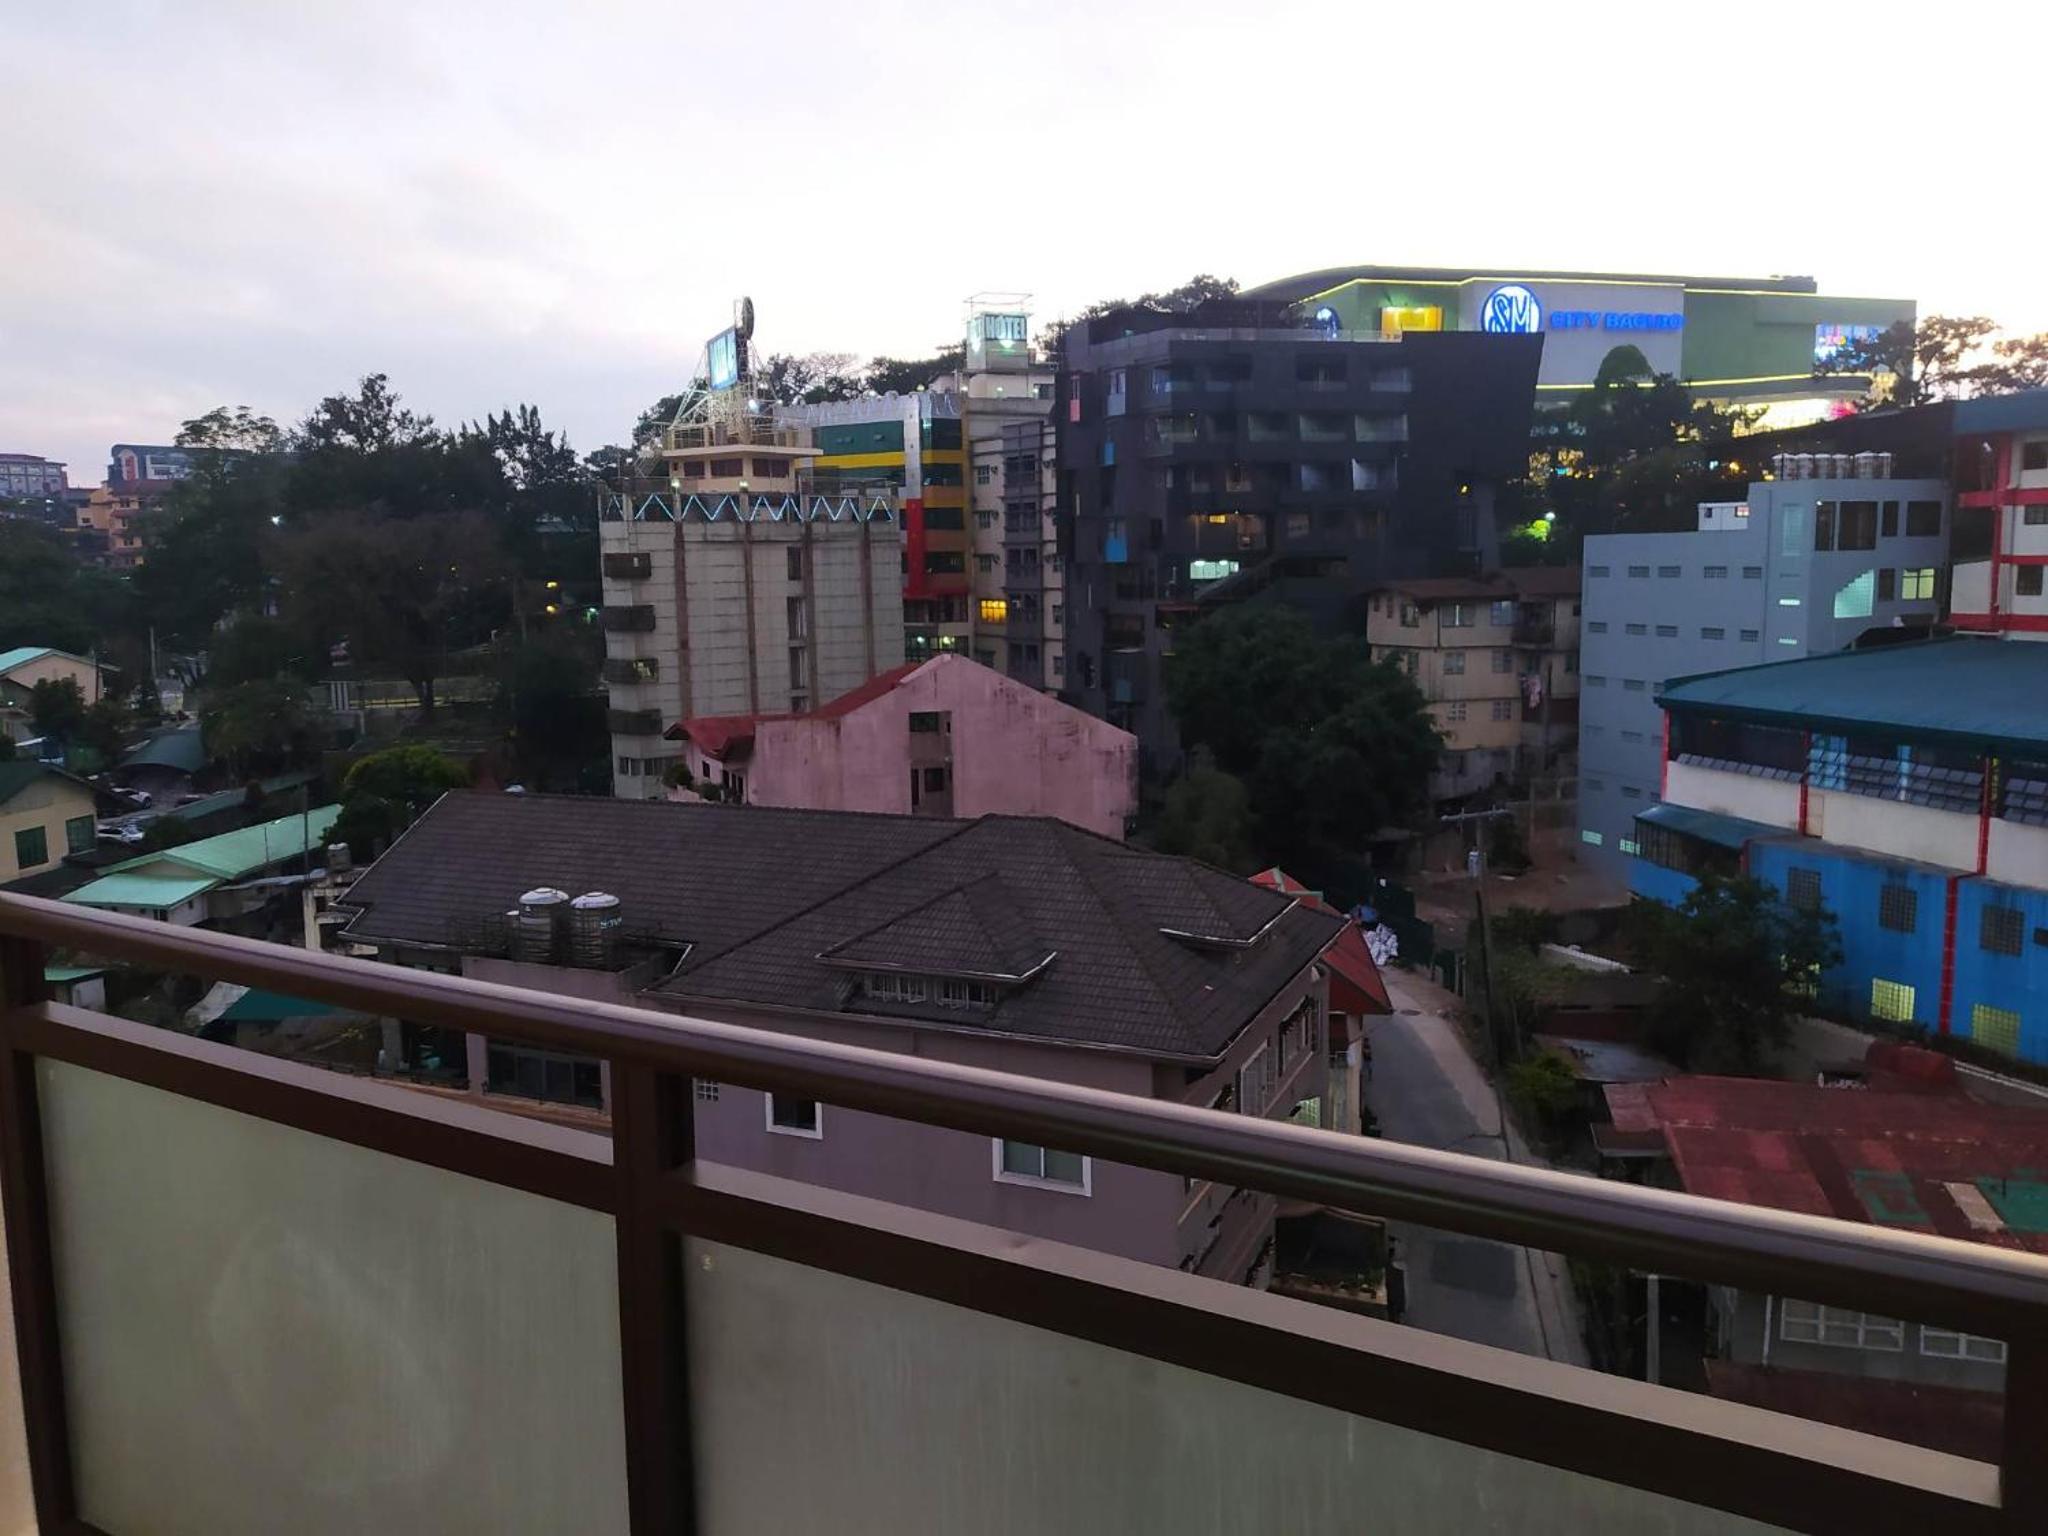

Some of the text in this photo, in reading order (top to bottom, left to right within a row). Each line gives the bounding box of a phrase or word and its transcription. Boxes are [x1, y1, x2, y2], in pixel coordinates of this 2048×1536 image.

[985, 315, 1026, 340] HOTEL
[1489, 292, 1533, 332] SM
[1551, 311, 1601, 328] CITY
